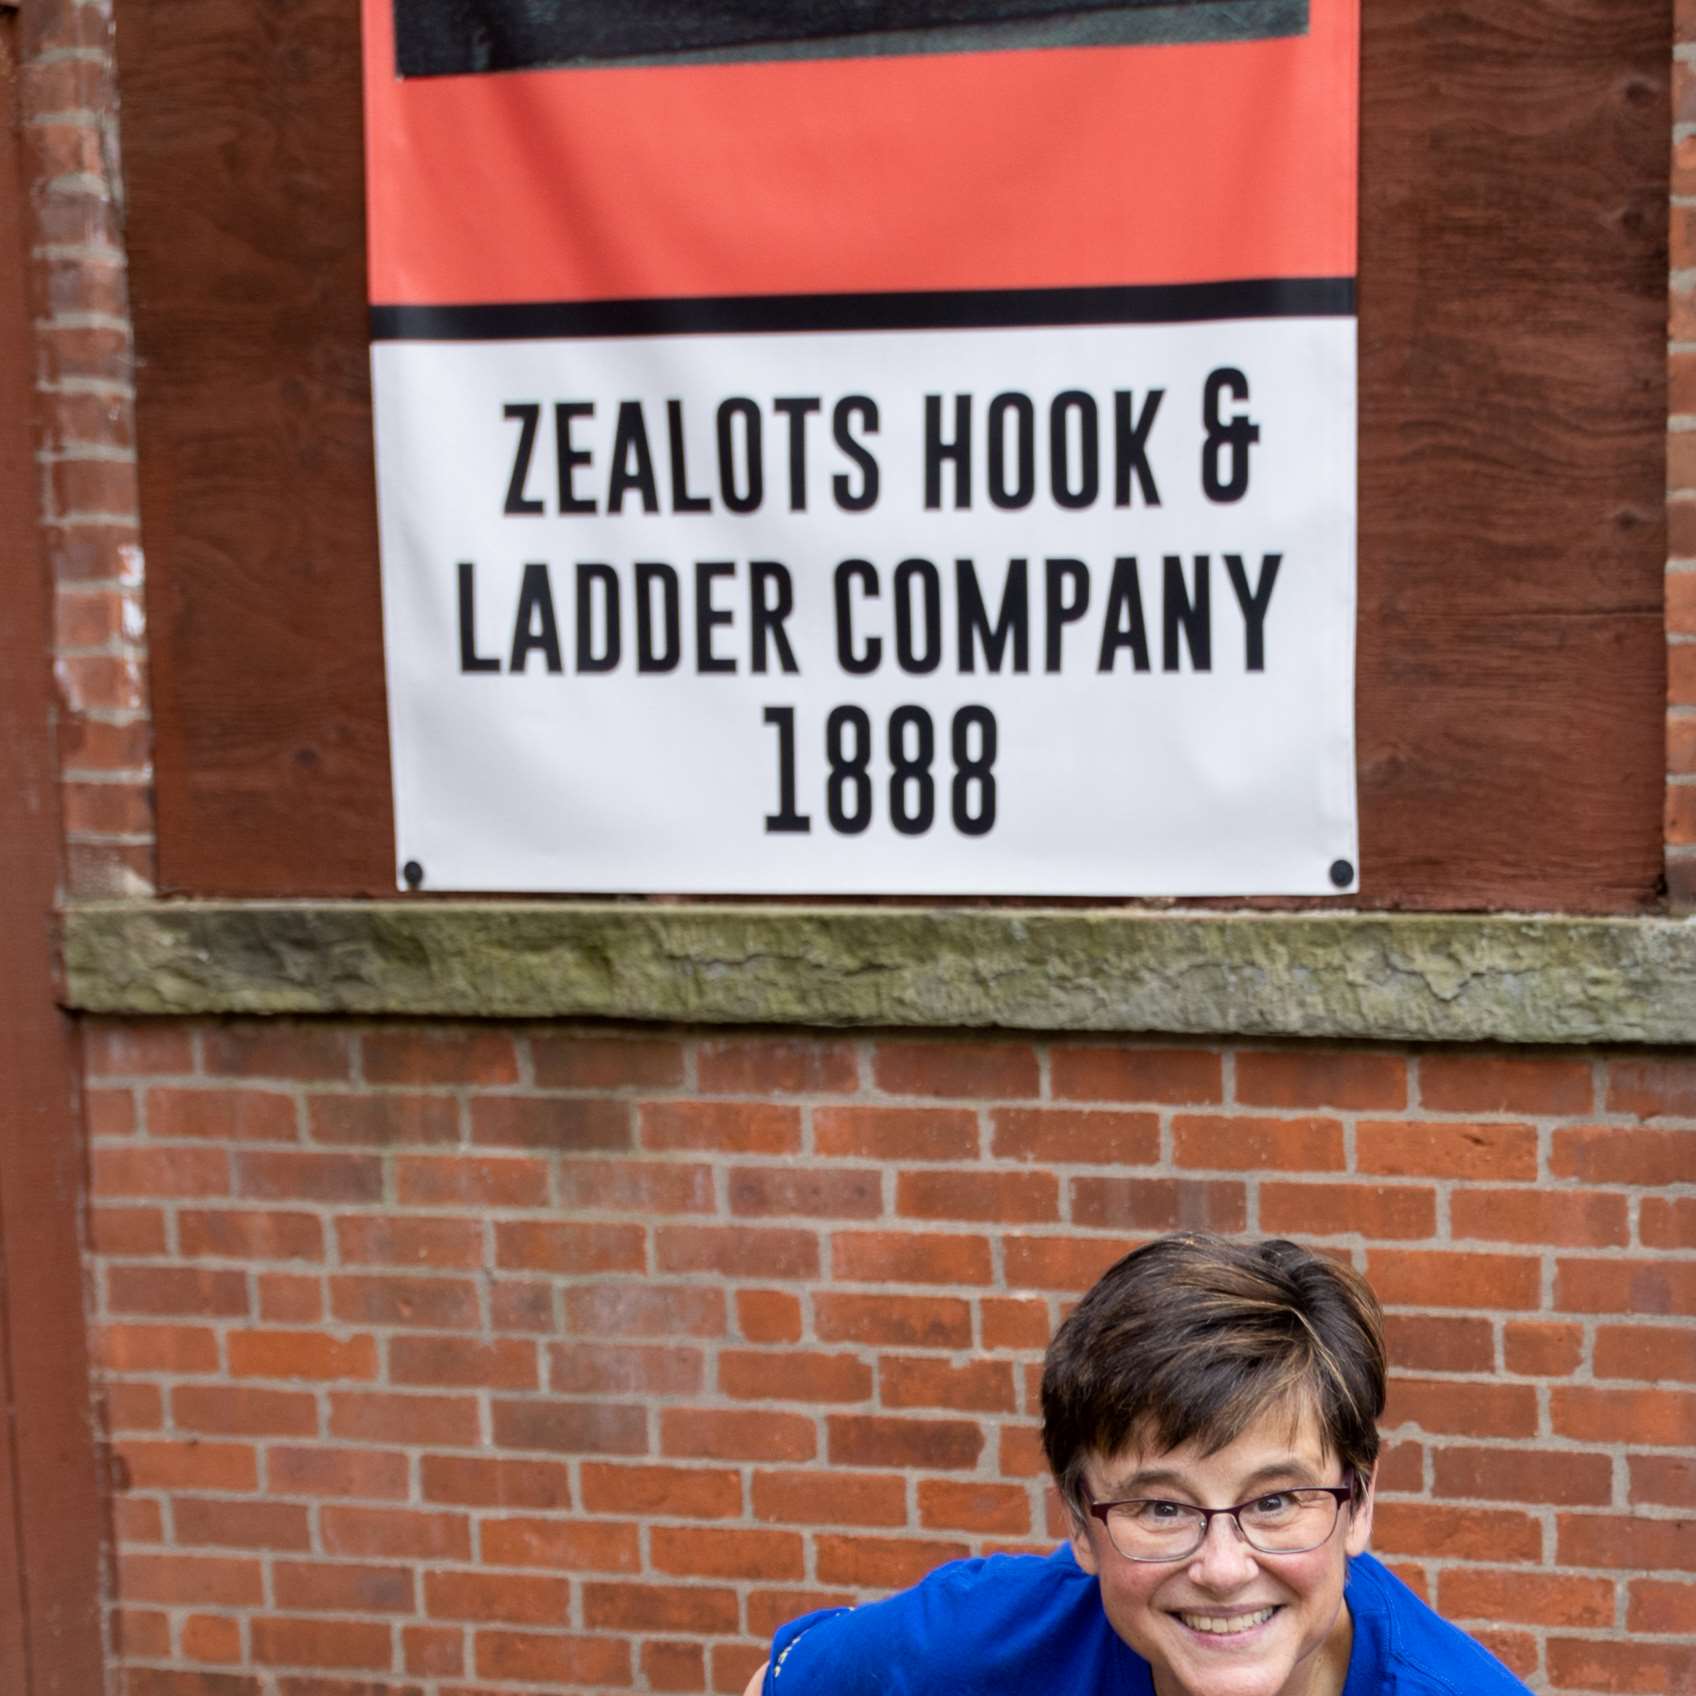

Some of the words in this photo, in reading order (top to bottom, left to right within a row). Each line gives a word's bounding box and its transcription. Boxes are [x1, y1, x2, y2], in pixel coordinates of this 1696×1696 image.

[501, 395, 882, 516] ZEALOTS
[923, 387, 1167, 510] HOOK
[1201, 366, 1261, 504] &
[456, 560, 800, 677] LADDER
[834, 552, 1283, 677] COMPANY
[763, 704, 999, 837] 1888
